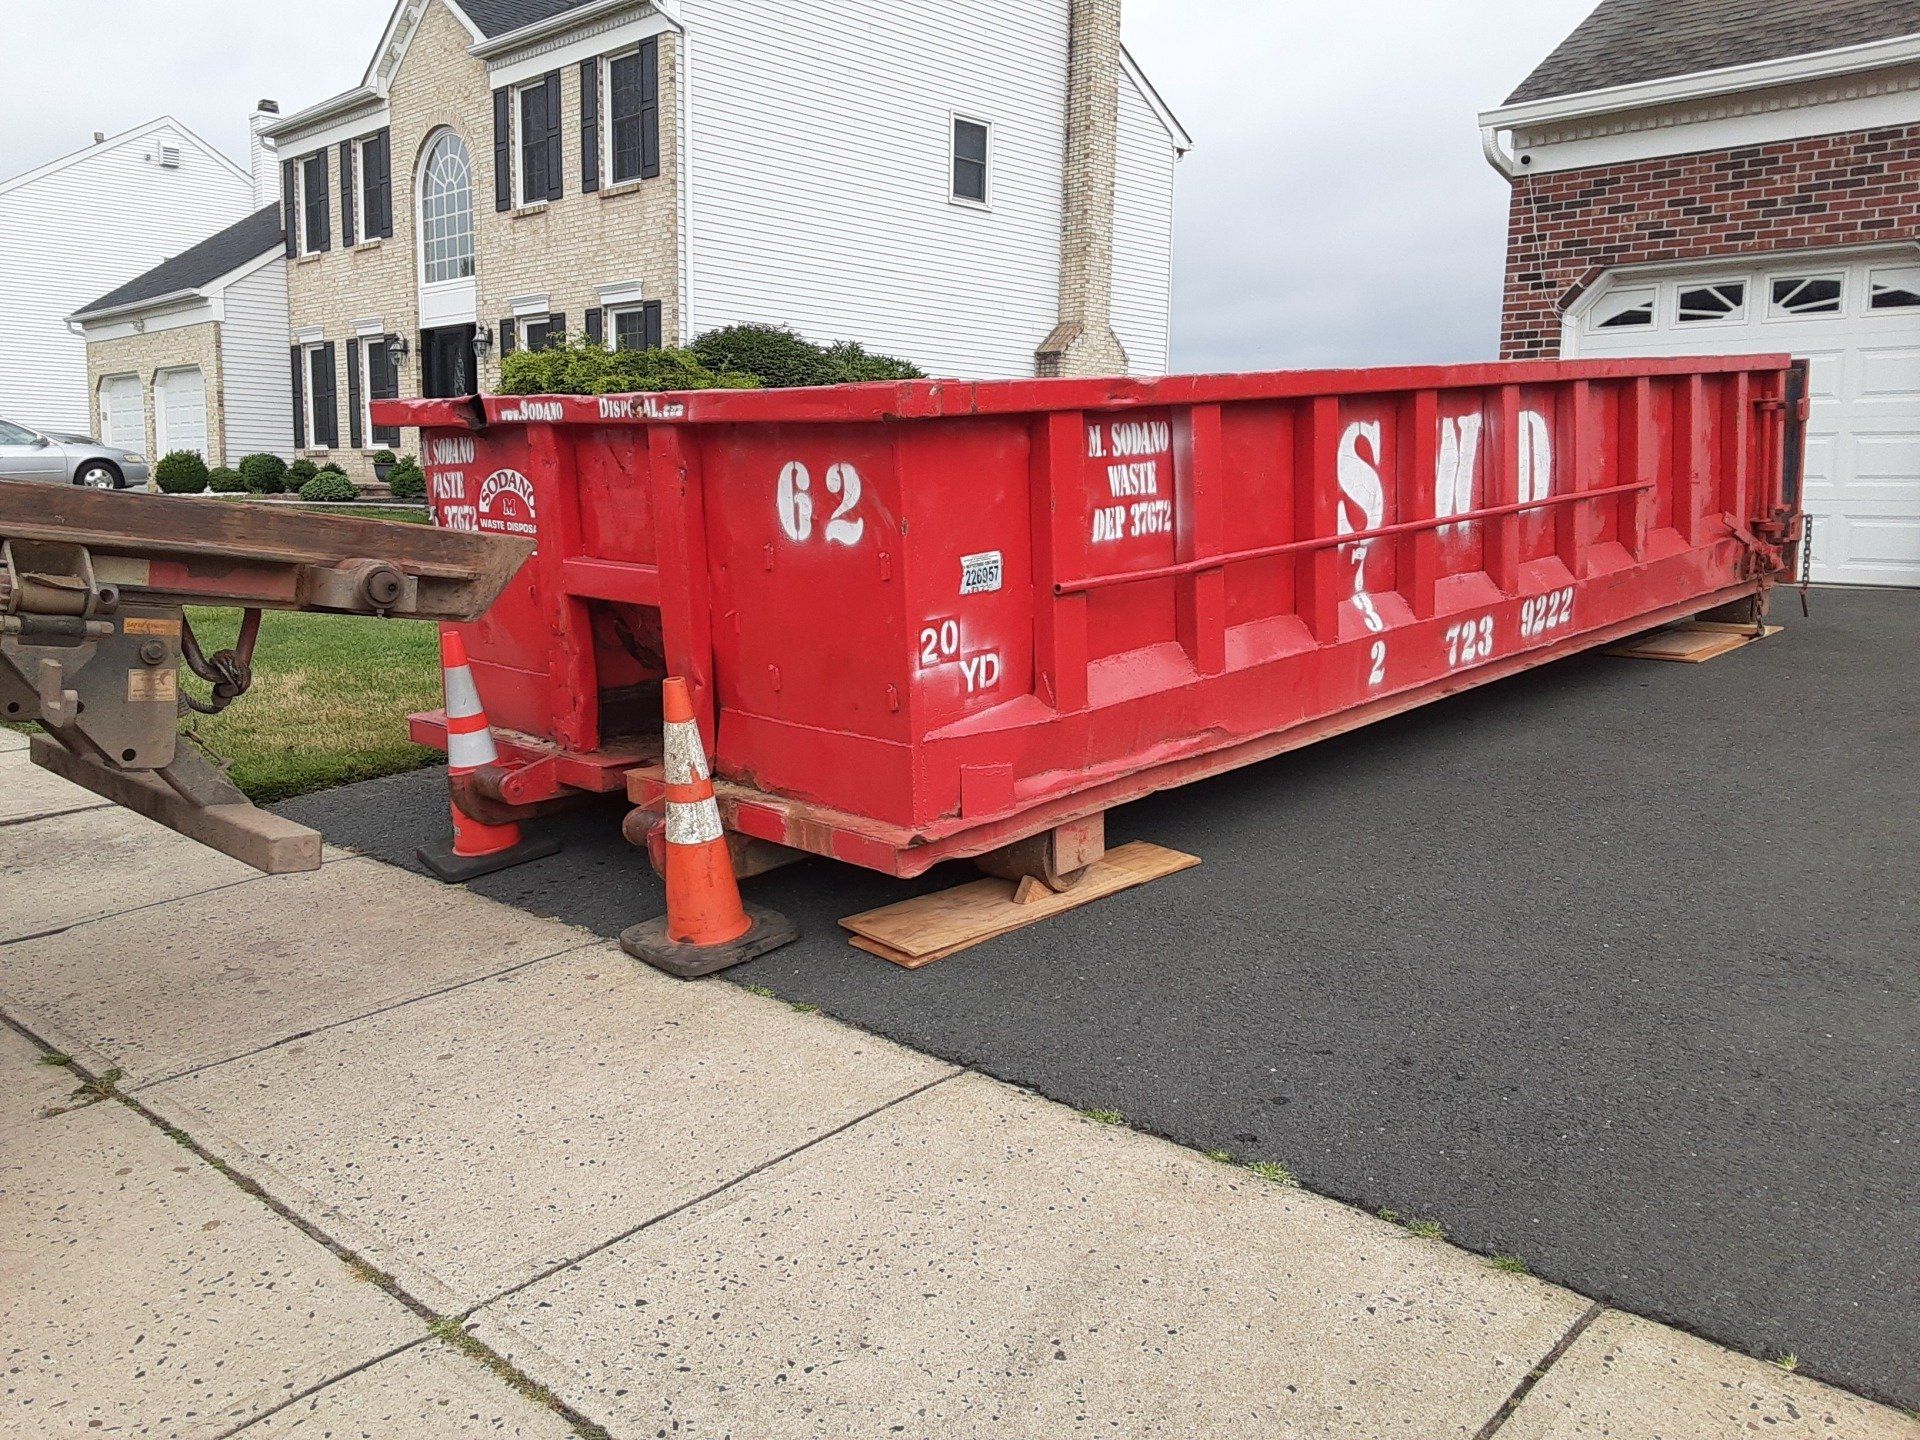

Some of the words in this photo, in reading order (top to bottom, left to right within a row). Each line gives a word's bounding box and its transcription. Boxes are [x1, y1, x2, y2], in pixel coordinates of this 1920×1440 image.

[432, 437, 475, 466] SODANO
[1088, 425, 1107, 458] M.
[1111, 421, 1169, 457] SODANO
[1107, 460, 1157, 497] WASTE
[502, 497, 517, 516] M
[777, 461, 864, 545] 62
[1091, 505, 1126, 543] DEP
[1130, 499, 1172, 538] 37672
[480, 518, 506, 530] WASTE
[965, 565, 999, 586] 226957
[1446, 615, 1494, 666] 723
[1521, 586, 1574, 638] 9222
[920, 619, 958, 665] 20
[959, 652, 999, 693] YD
